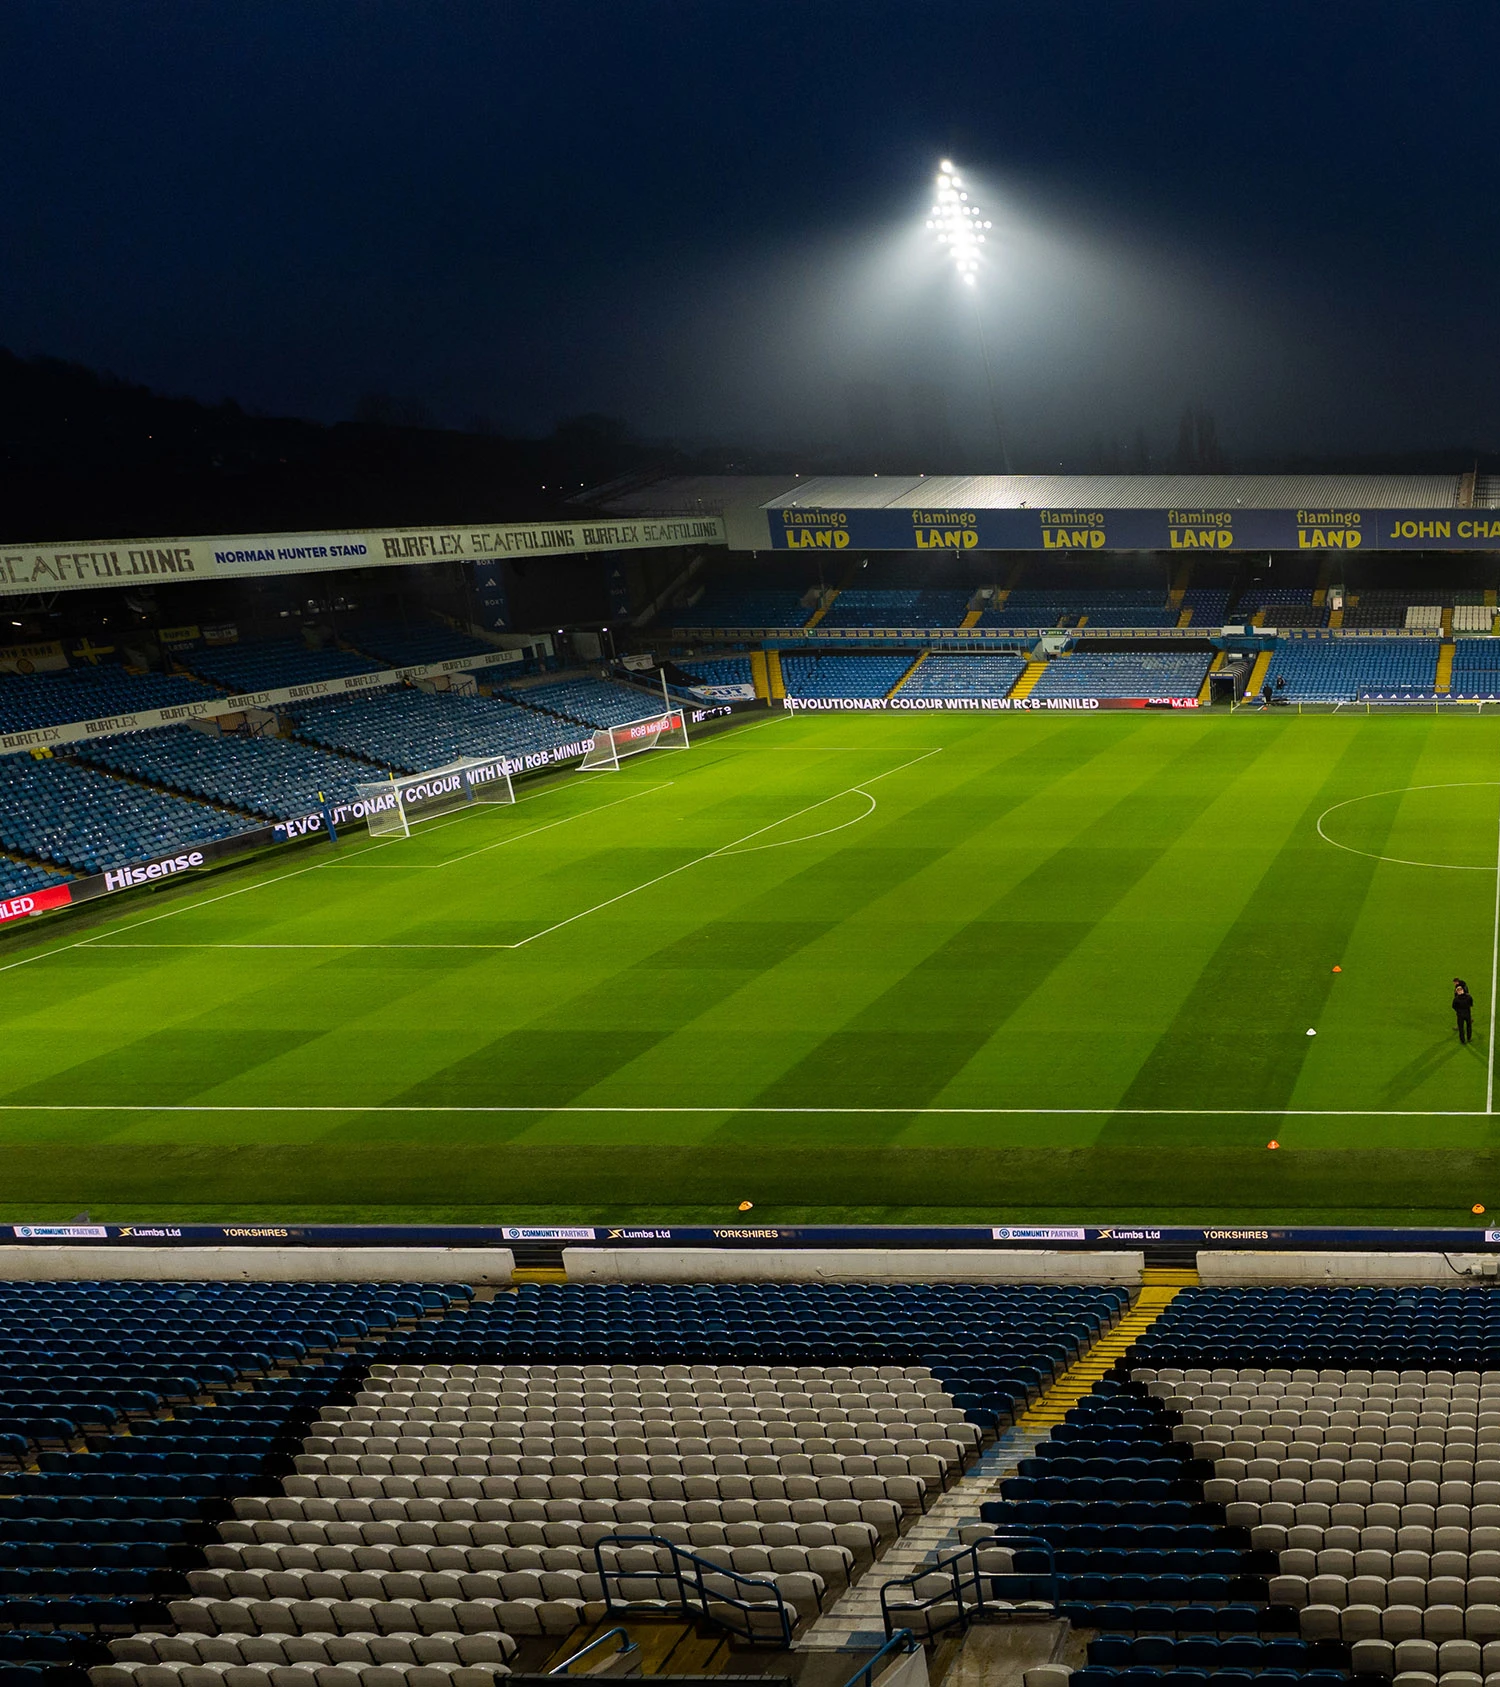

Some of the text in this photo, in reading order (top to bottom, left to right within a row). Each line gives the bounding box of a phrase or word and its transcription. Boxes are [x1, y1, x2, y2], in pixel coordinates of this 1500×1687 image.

[782, 510, 847, 527] flamingo
[912, 510, 976, 527] flamingo
[1040, 509, 1104, 527] flamingo
[1168, 510, 1232, 527] flamingo
[1297, 510, 1361, 527] flamingo
[583, 522, 717, 546] BURFLEX SCAFFOLDING
[1390, 520, 1451, 539] JOHN
[382, 529, 575, 559] BURFLEX SCAFFOLDING
[786, 530, 850, 549] LAND
[915, 530, 979, 549] LAND
[1042, 530, 1106, 549] LAND
[1169, 529, 1233, 548] LAND
[1298, 529, 1362, 548] LAND
[215, 544, 367, 564] NORMAN HUNTER STAND
[442, 659, 472, 671] BURFLEX
[485, 652, 514, 664] BURFLEX
[344, 674, 381, 689] BURFLEX
[289, 683, 328, 698] BURFLEX
[228, 693, 271, 708] BURFLEX
[783, 698, 1099, 710] REVOLUTIONARY COLOUR WITH NEW RGB-MINILED
[160, 703, 208, 720] BURFLEX
[85, 716, 138, 734] BURFLEX
[630, 725, 647, 738] RGB
[2, 728, 61, 748] BURFLEX
[405, 775, 461, 804] COLOUR
[497, 757, 525, 777] NEW
[525, 738, 595, 768] RGB-MINILED
[105, 851, 204, 892] Hisense
[34, 1227, 101, 1236] COMMUNITY PARTNER
[134, 1228, 182, 1237] Lumbs Ltd
[222, 1228, 288, 1237] YORKSHIRES
[522, 1229, 589, 1238] COMMUNITY PARTNER
[623, 1229, 671, 1239] Lumbs Ltd
[713, 1230, 778, 1239] YORKSHIRES
[1012, 1230, 1079, 1239] COMMUNITY PARTNER
[1113, 1230, 1161, 1239] Lumbs Ltd
[1203, 1230, 1269, 1239] YORKSHIRES
